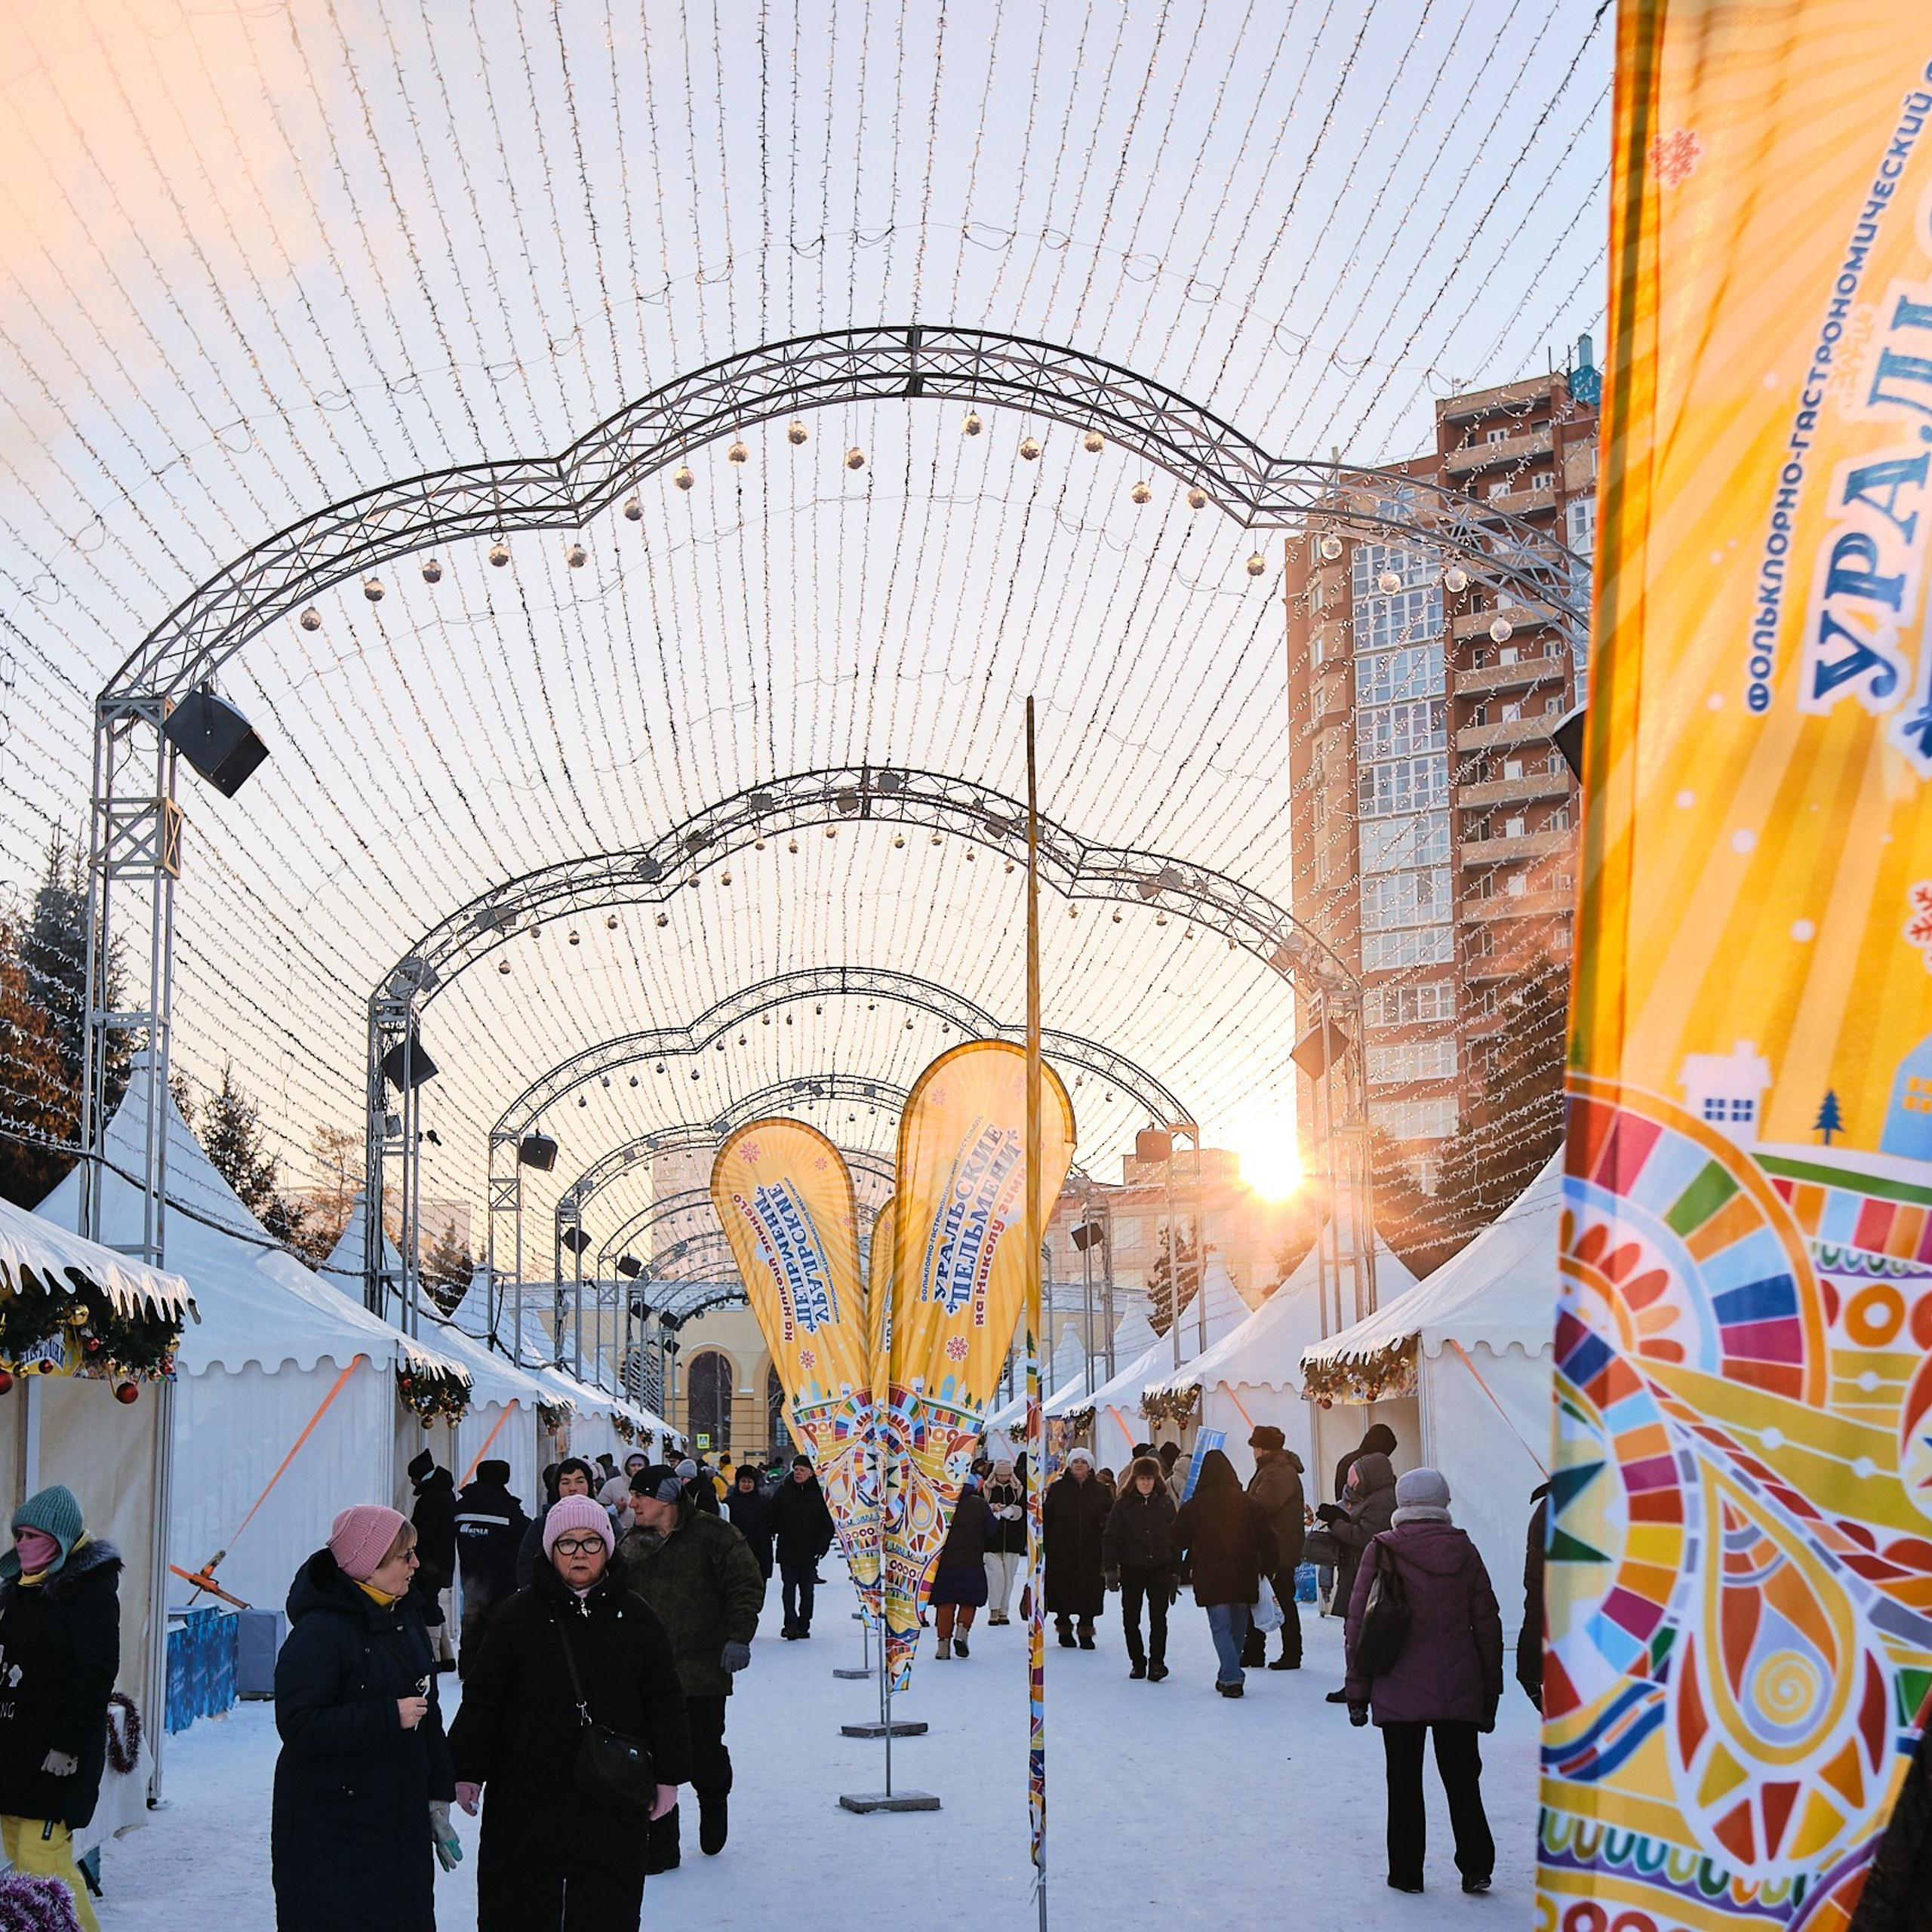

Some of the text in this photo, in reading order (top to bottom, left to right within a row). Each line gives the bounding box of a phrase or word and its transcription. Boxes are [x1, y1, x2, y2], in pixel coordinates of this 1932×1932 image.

[1749, 92, 1932, 712] ФОЛЬКЛОРНО-ГАСТРОНОМИЧЕСКИЙ
[934, 1124, 1003, 1300] УРАЛЬСКИЕ
[951, 1140, 1021, 1302] ПЕЛЬМЕНИ
[976, 1219, 1005, 1294] Николу
[976, 1300, 984, 1325] на
[0, 1702, 14, 1719] NG
